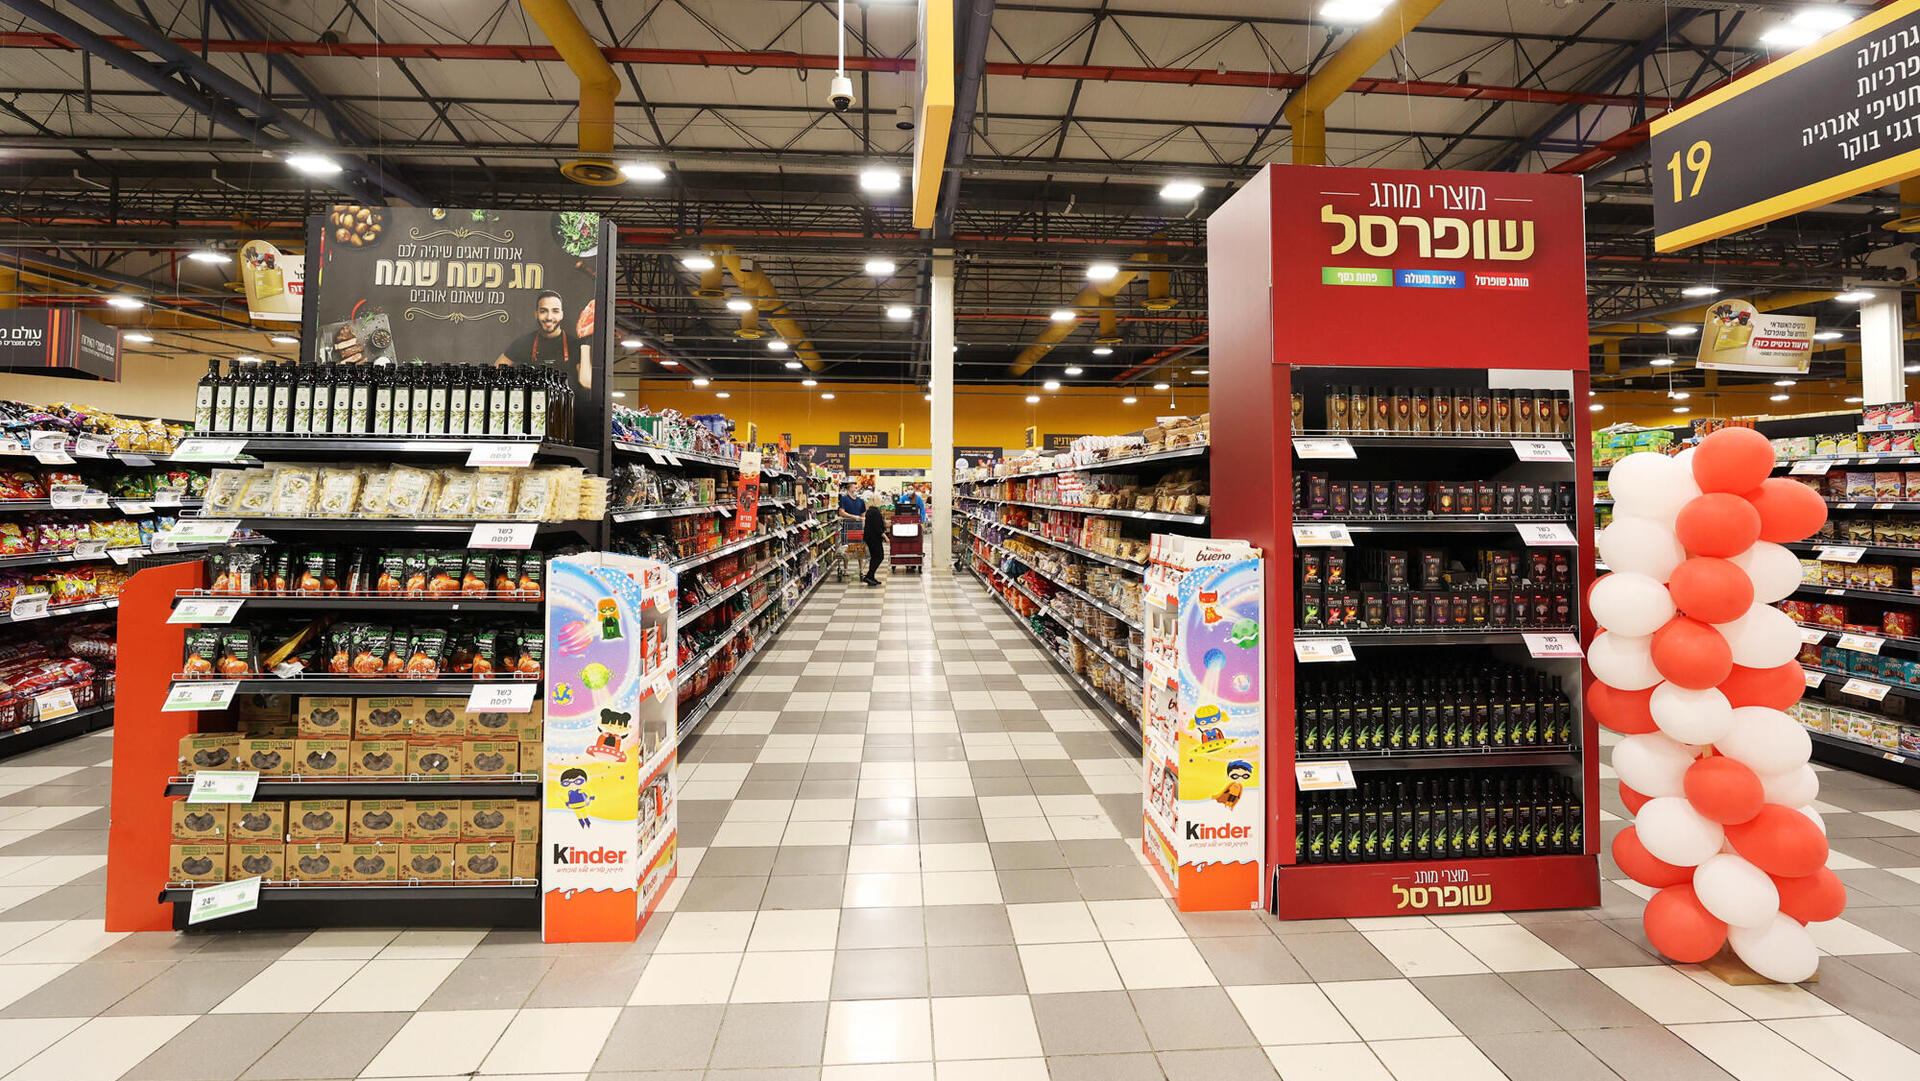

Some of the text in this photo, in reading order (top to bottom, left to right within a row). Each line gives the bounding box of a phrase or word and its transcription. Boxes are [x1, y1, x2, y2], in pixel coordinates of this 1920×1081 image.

[1857, 25, 1920, 69] גרנולה
[1856, 55, 1920, 98] פרכיות
[1802, 85, 1920, 147] חטיפי אנרגיה
[1838, 129, 1881, 161] בוקר
[1666, 139, 1712, 204] 19
[1369, 182, 1487, 211] מוצרי מותג
[1320, 204, 1535, 261] שופרסל
[398, 242, 522, 260] אנחנו דואגים שיהיה לכם
[374, 258, 544, 289] חג פסח שמח
[1337, 271, 1377, 283] פחות כסף
[1404, 272, 1456, 286] איכות מעולה
[1475, 274, 1530, 288] מותג שופרסל
[410, 289, 505, 304] כמו שאתם אוהבים
[12, 326, 42, 339] עולם
[1196, 550, 1231, 562] bueno
[1186, 820, 1252, 841] Kinder
[553, 843, 627, 865] Kinder
[1414, 869, 1469, 884] מוצרי מותג
[1392, 883, 1492, 909] שופרסל
